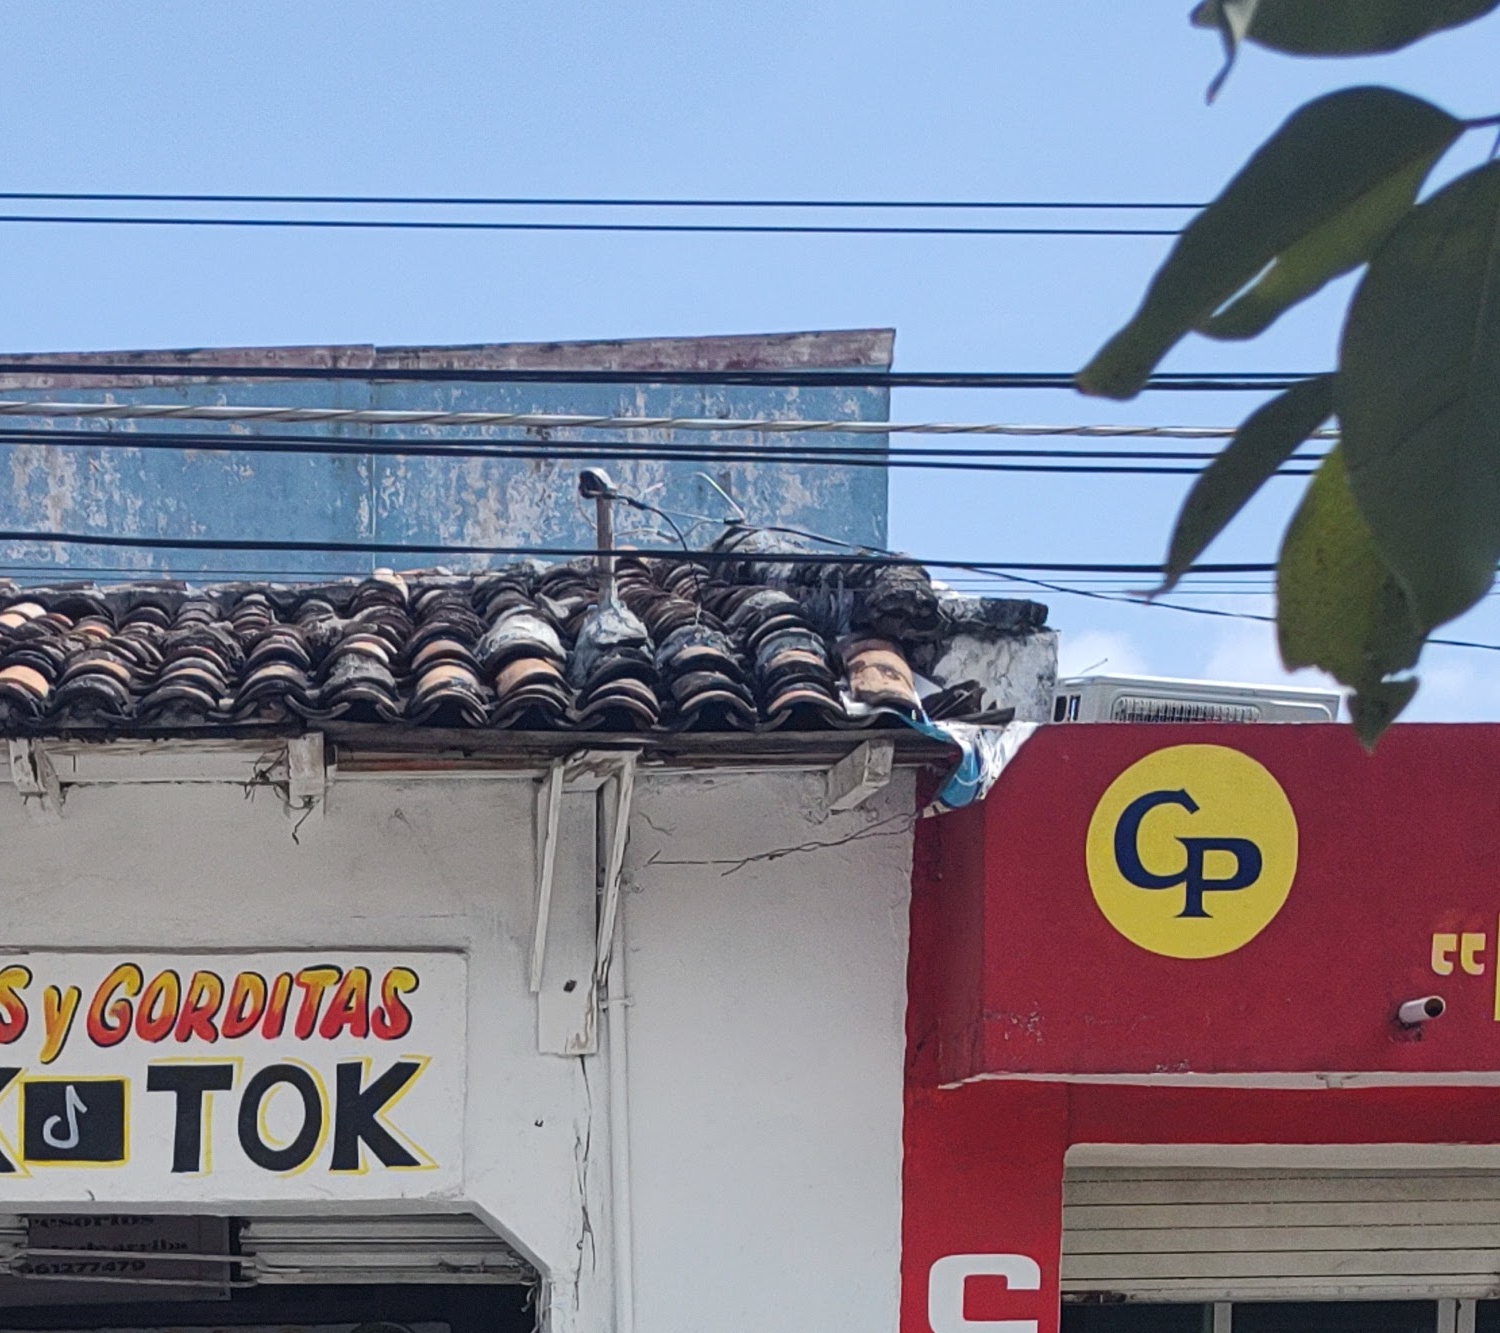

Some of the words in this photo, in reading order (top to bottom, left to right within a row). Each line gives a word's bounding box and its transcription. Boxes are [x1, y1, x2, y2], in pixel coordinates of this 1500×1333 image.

[41, 984, 82, 1064] y
[85, 961, 420, 1048] GORDITAS
[146, 1060, 426, 1174] TOK
